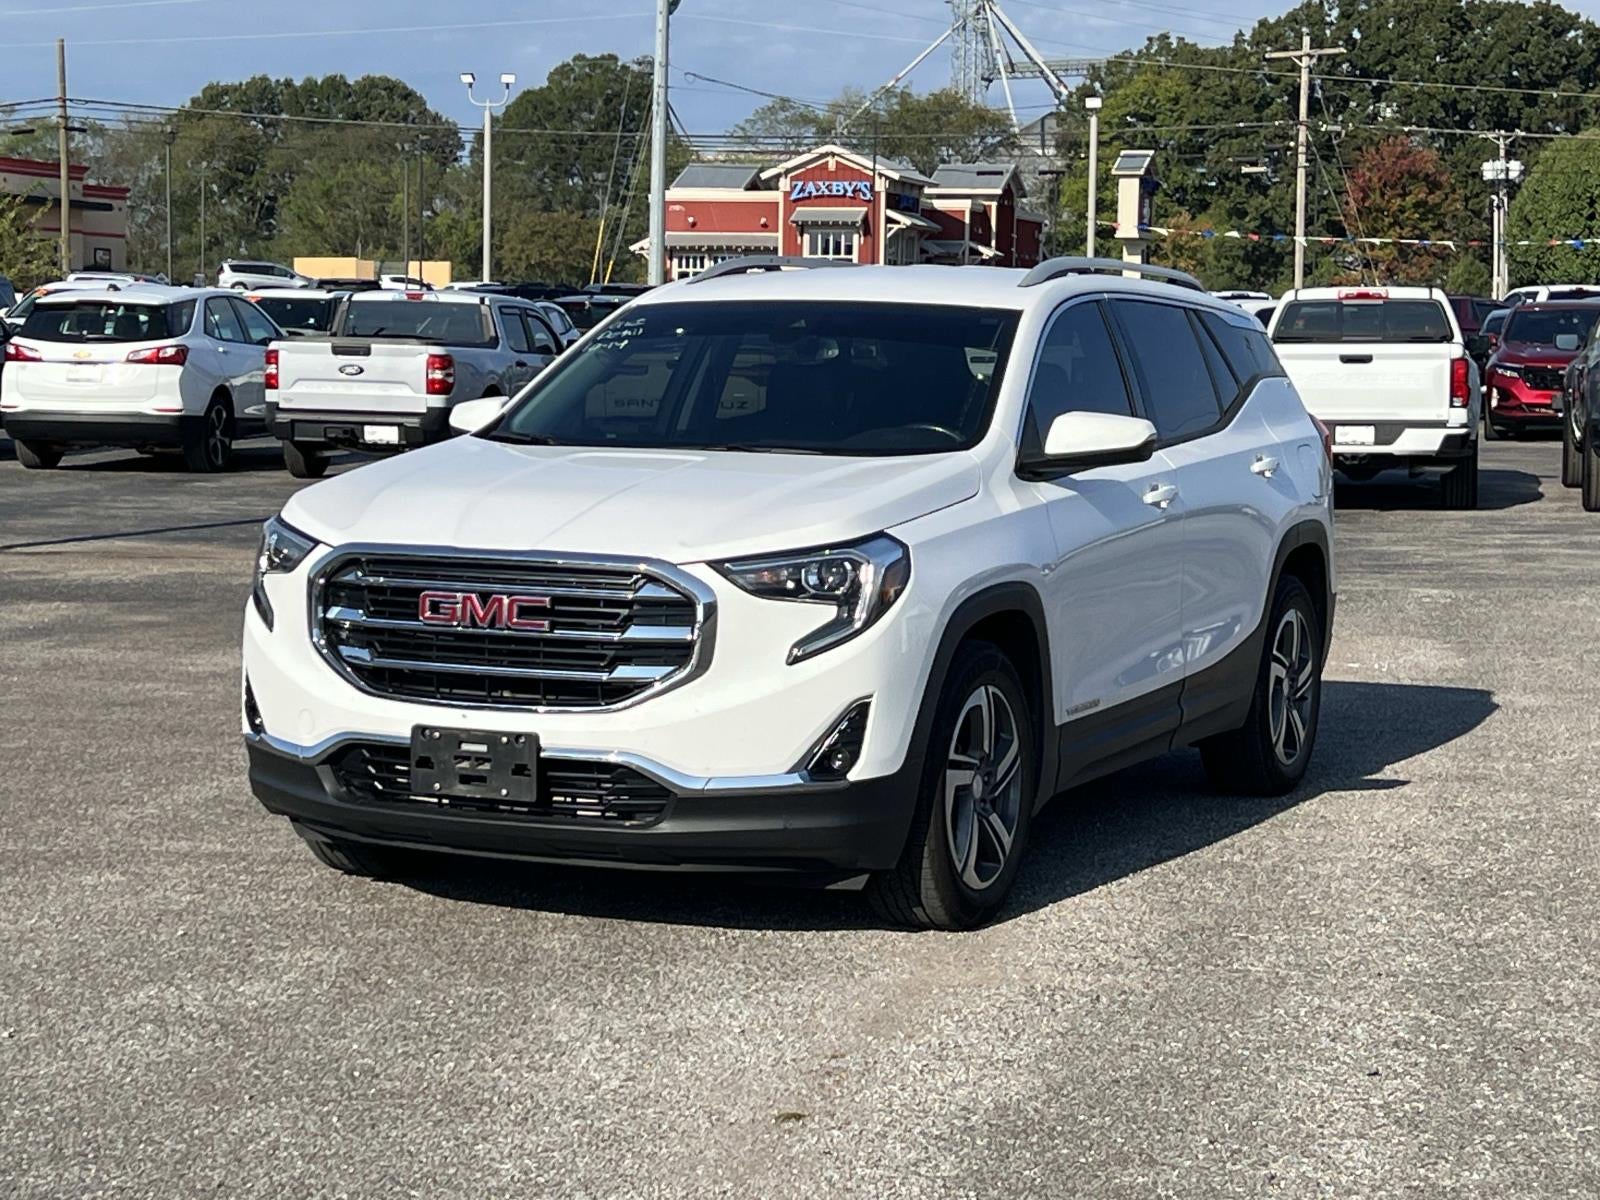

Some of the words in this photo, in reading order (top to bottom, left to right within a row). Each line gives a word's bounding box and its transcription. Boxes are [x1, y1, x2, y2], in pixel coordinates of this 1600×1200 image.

[790, 181, 873, 202] ZAXBY'S
[614, 399, 660, 409] SAN
[720, 400, 748, 410] UZ
[418, 590, 551, 632] GMC
